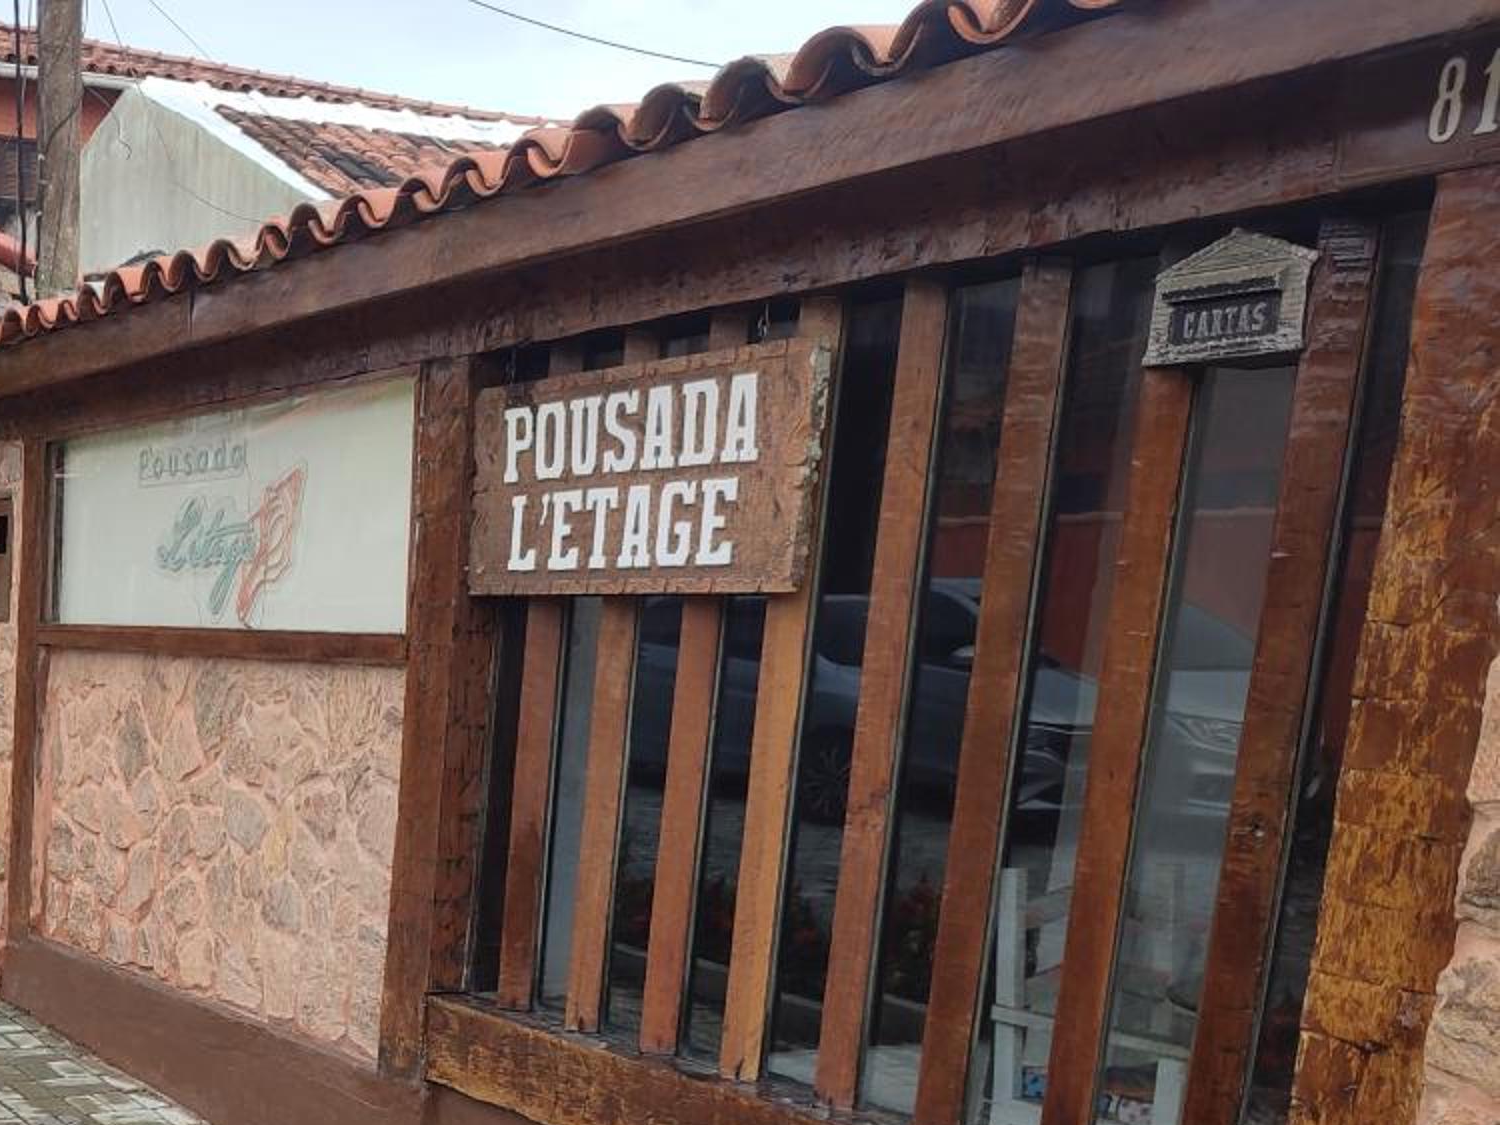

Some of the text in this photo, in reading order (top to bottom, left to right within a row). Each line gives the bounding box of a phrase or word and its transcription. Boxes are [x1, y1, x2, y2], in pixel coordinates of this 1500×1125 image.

[1428, 47, 1500, 144] 81
[1183, 302, 1267, 338] CARTAS
[139, 438, 247, 480] Pousada
[503, 372, 759, 483] POUSADA
[507, 477, 739, 571] L'ETAGE
